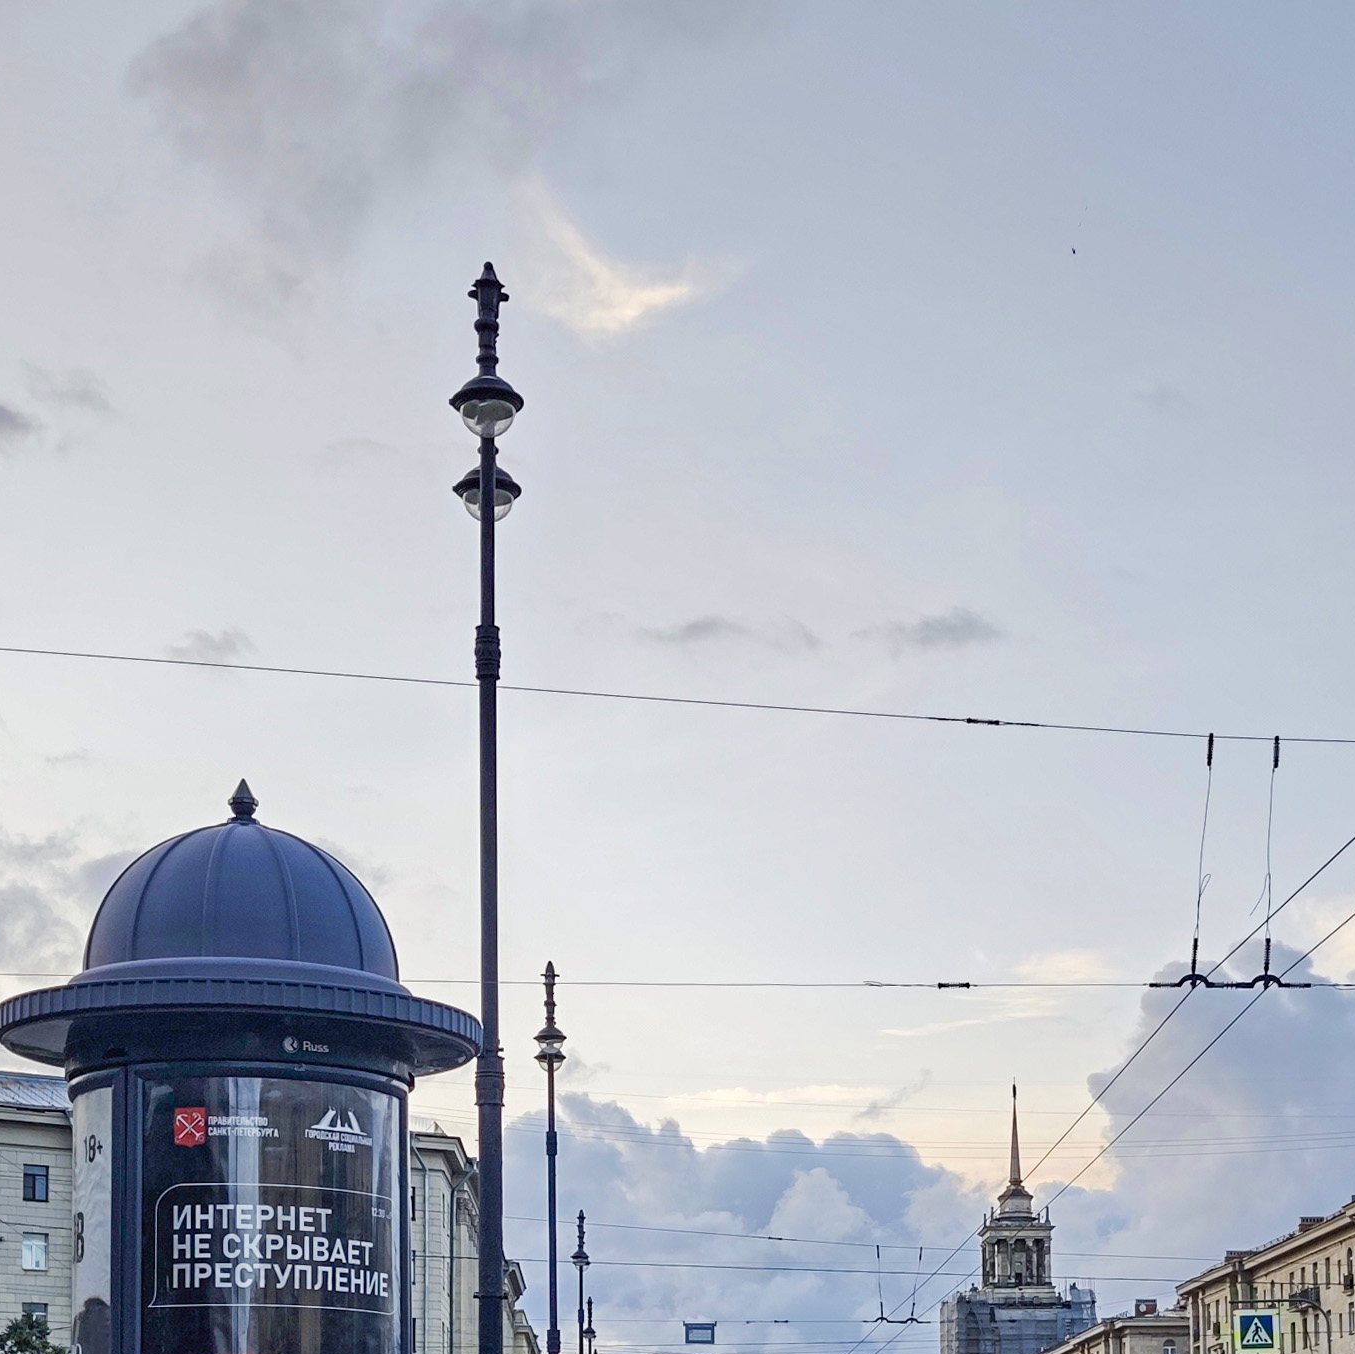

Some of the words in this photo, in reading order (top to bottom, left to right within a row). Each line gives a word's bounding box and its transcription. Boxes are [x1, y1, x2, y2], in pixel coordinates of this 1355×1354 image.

[302, 1040, 330, 1053] Russ
[207, 1116, 269, 1127] ПРАВИТЕЛЬСТВО
[207, 1127, 280, 1138] САНКТ-ПЕТЕРБУРГА
[304, 1129, 340, 1141] ГОРОДСКАЯ
[84, 1134, 103, 1163] 18+
[328, 1142, 356, 1153] РЕКЛАМА
[172, 1203, 333, 1233] ИНТЕРНЕТ
[172, 1233, 212, 1260] НЕ
[222, 1233, 374, 1266] СКРЫВАЕТ
[172, 1262, 389, 1298] ПРЕСТУПЛЕНИЕ
